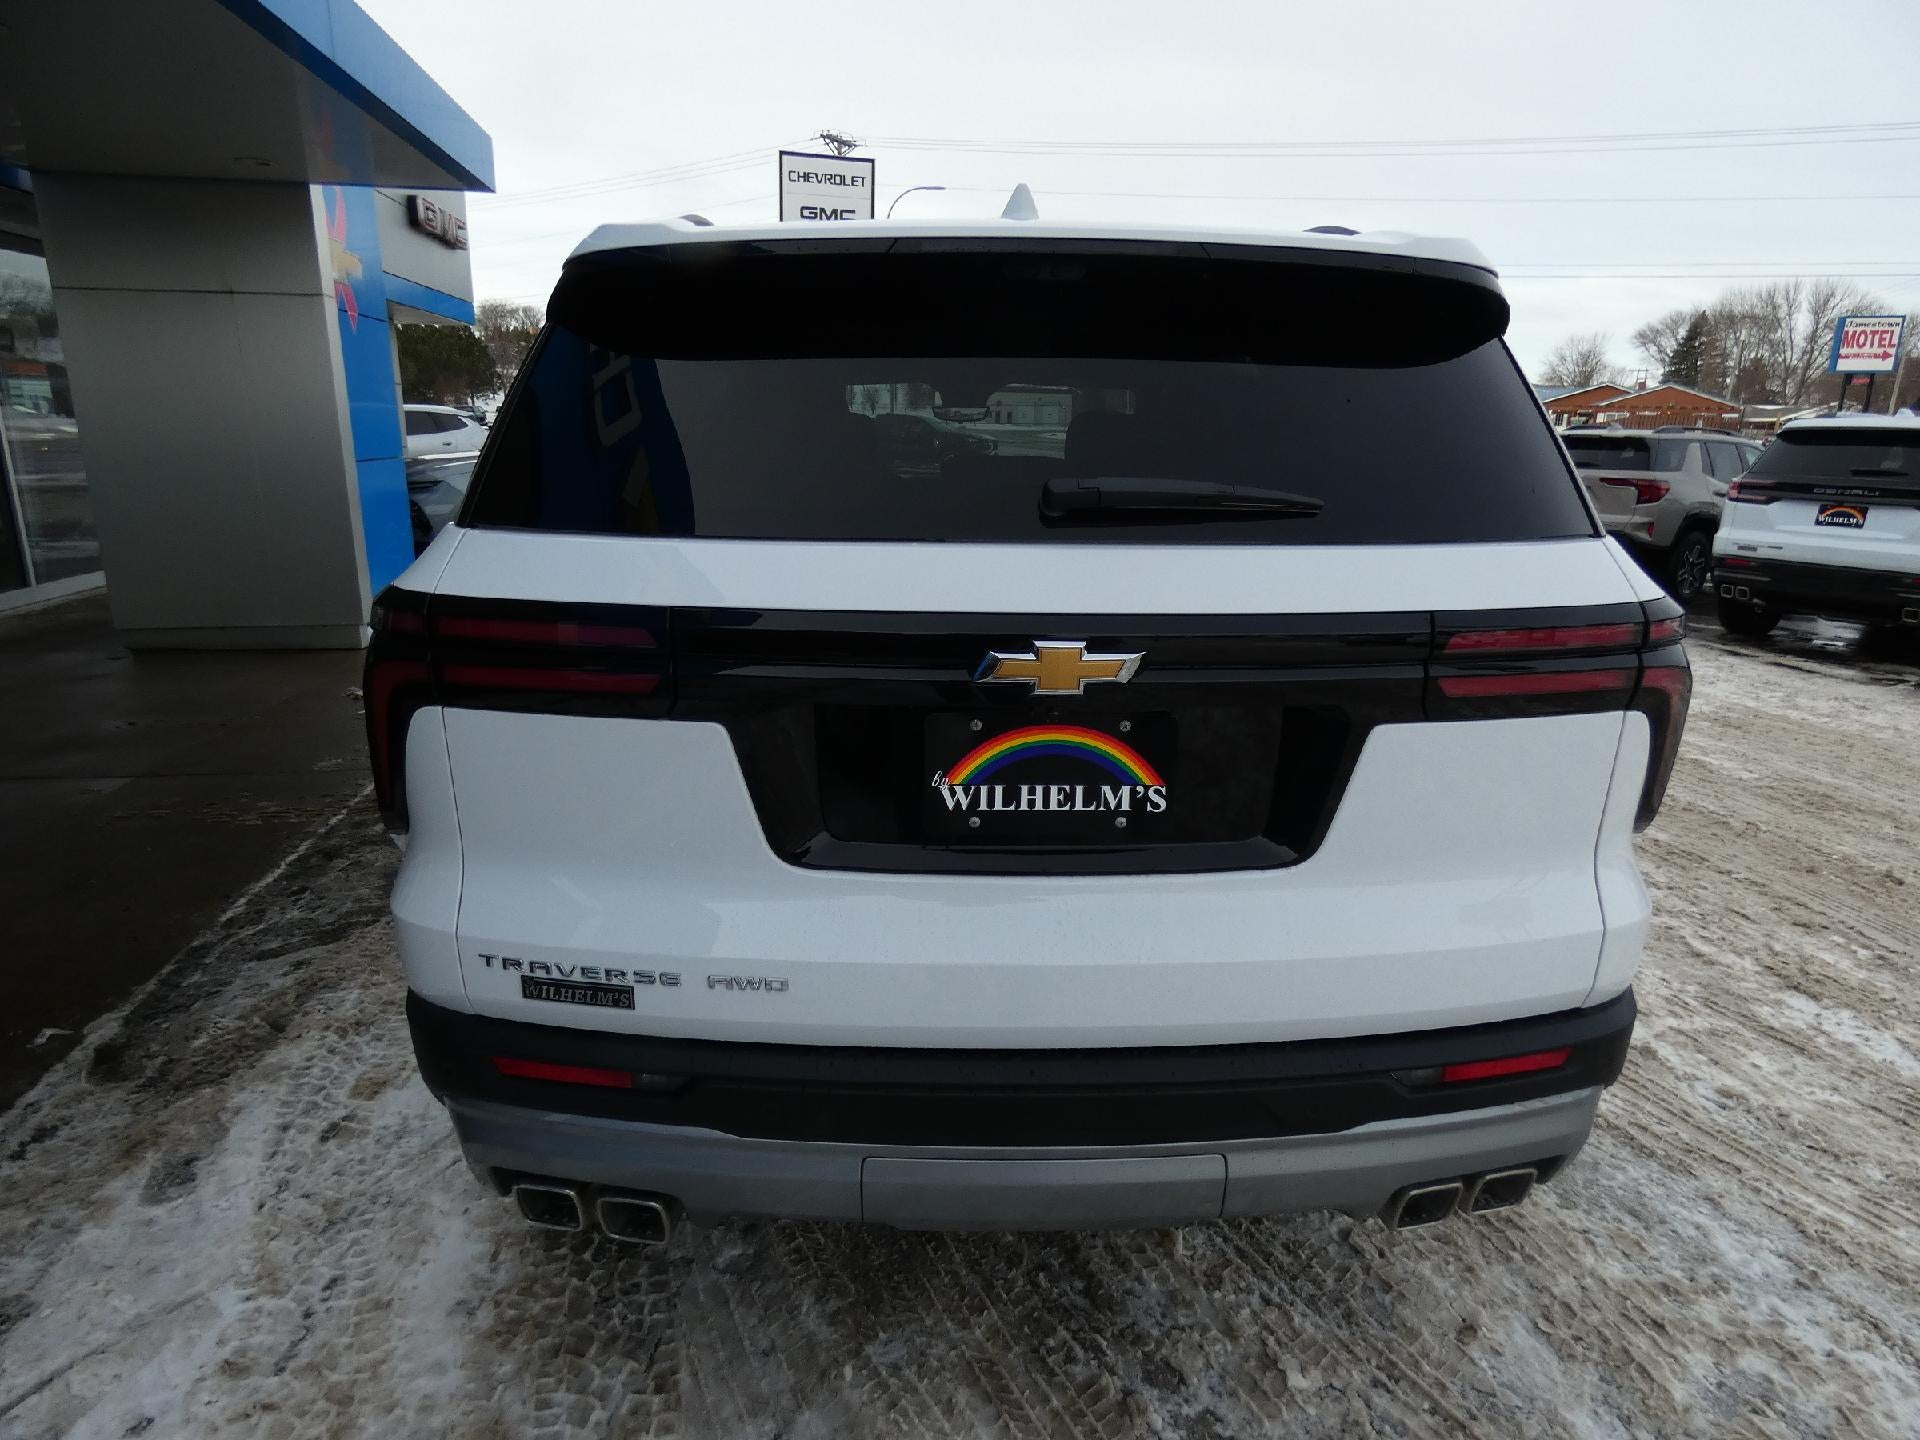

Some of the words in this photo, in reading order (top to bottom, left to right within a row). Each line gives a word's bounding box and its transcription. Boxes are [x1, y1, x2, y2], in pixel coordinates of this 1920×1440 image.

[788, 170, 867, 187] CHEVROLET
[416, 196, 467, 248] GMC
[800, 205, 856, 221] GMC
[1842, 329, 1897, 349] MOTEL
[931, 770, 951, 790] by
[938, 784, 1167, 812] WILHELM'S
[478, 953, 682, 986] TRAVERSE
[707, 974, 789, 992] AWD
[525, 983, 631, 1008] WILHELM'S
